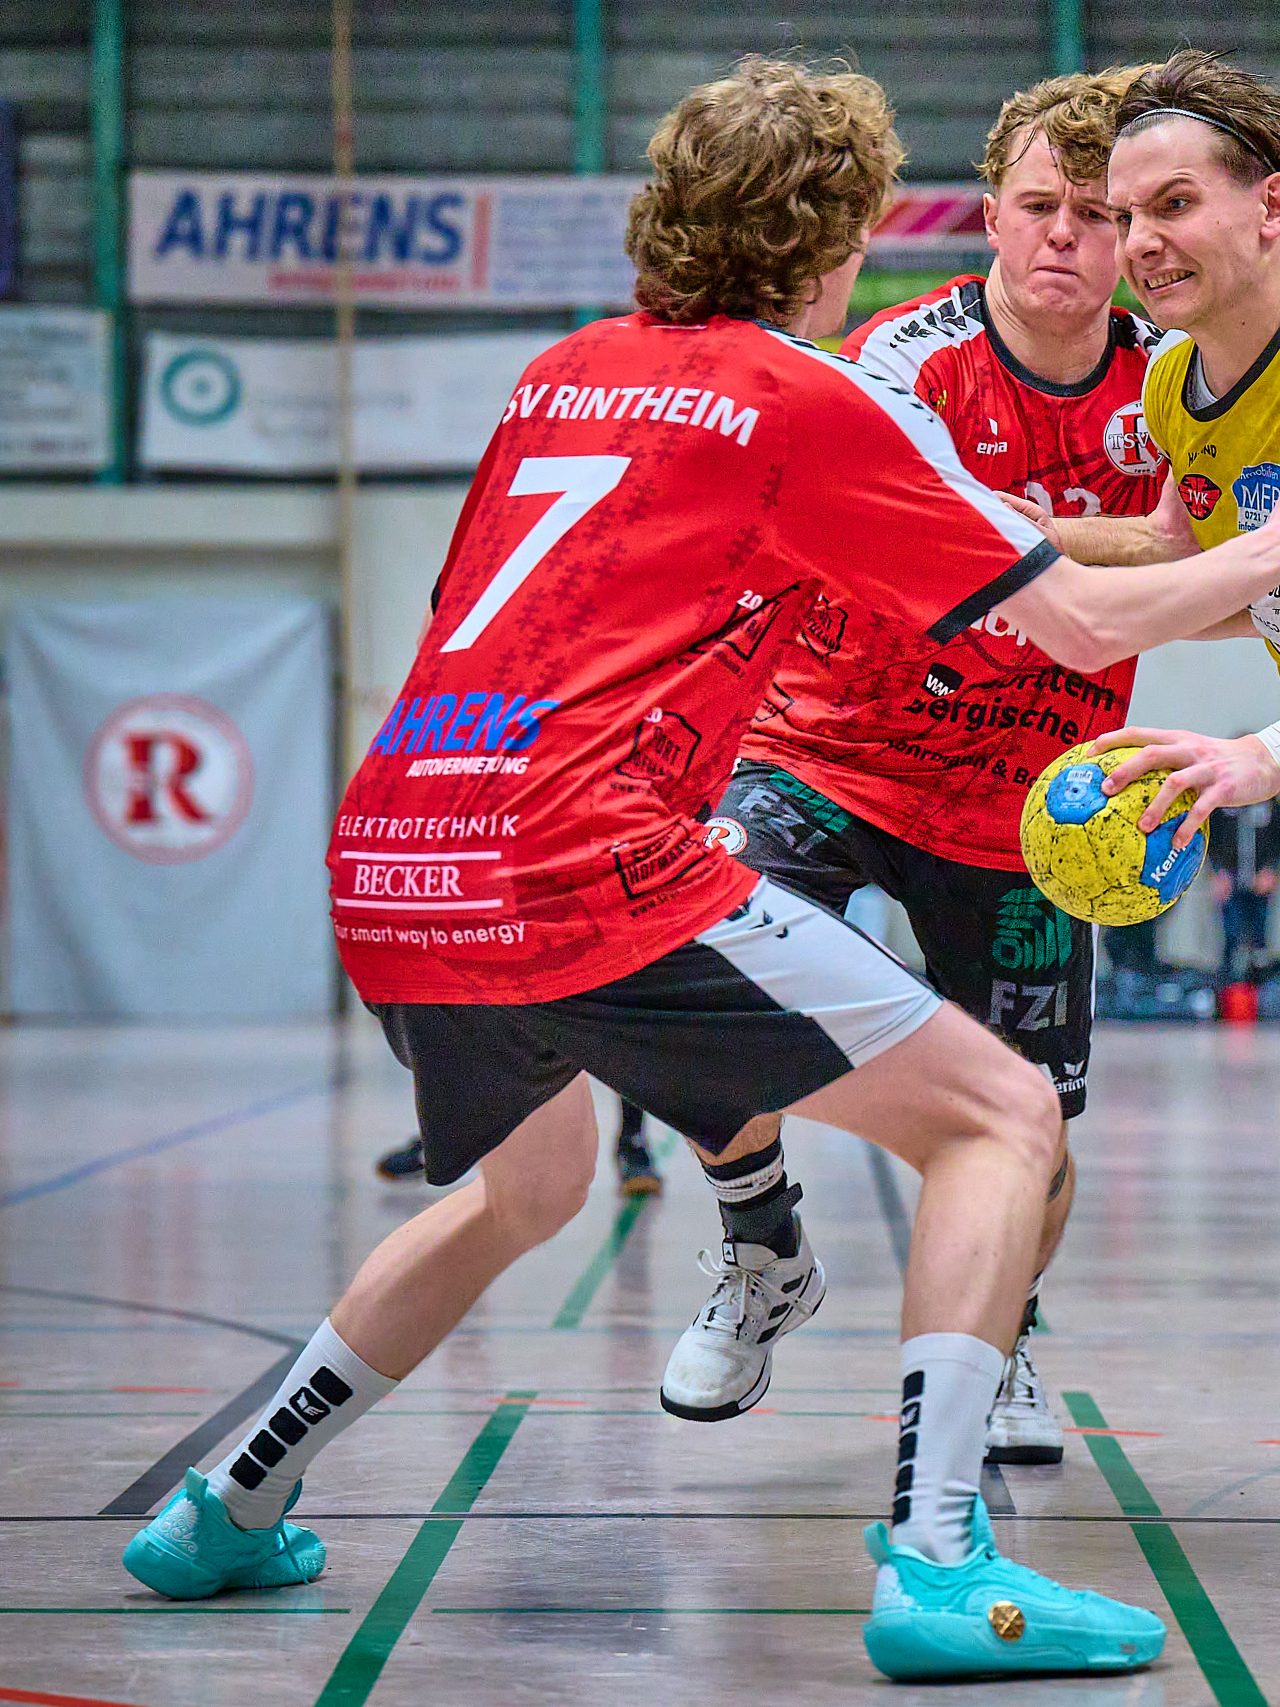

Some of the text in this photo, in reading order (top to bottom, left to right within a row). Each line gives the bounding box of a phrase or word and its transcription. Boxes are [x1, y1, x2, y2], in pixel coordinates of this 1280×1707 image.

[155, 190, 464, 265] AHRENS
[546, 384, 760, 447] RINTHEIM
[1108, 431, 1149, 450] TSV
[1187, 488, 1209, 505] TVK
[438, 454, 633, 653] 7
[367, 692, 562, 756] AHRENS
[405, 756, 531, 778] AUTOVERMIETUNG
[991, 758, 1009, 779] &
[338, 815, 521, 840] ELEKTROTECHNIK
[737, 784, 828, 854] FZI
[353, 864, 465, 898] BECKER
[351, 925, 394, 943] smart
[395, 929, 430, 950] way
[430, 926, 449, 945] to
[451, 921, 526, 946] energy
[989, 978, 1068, 1032] FZI
